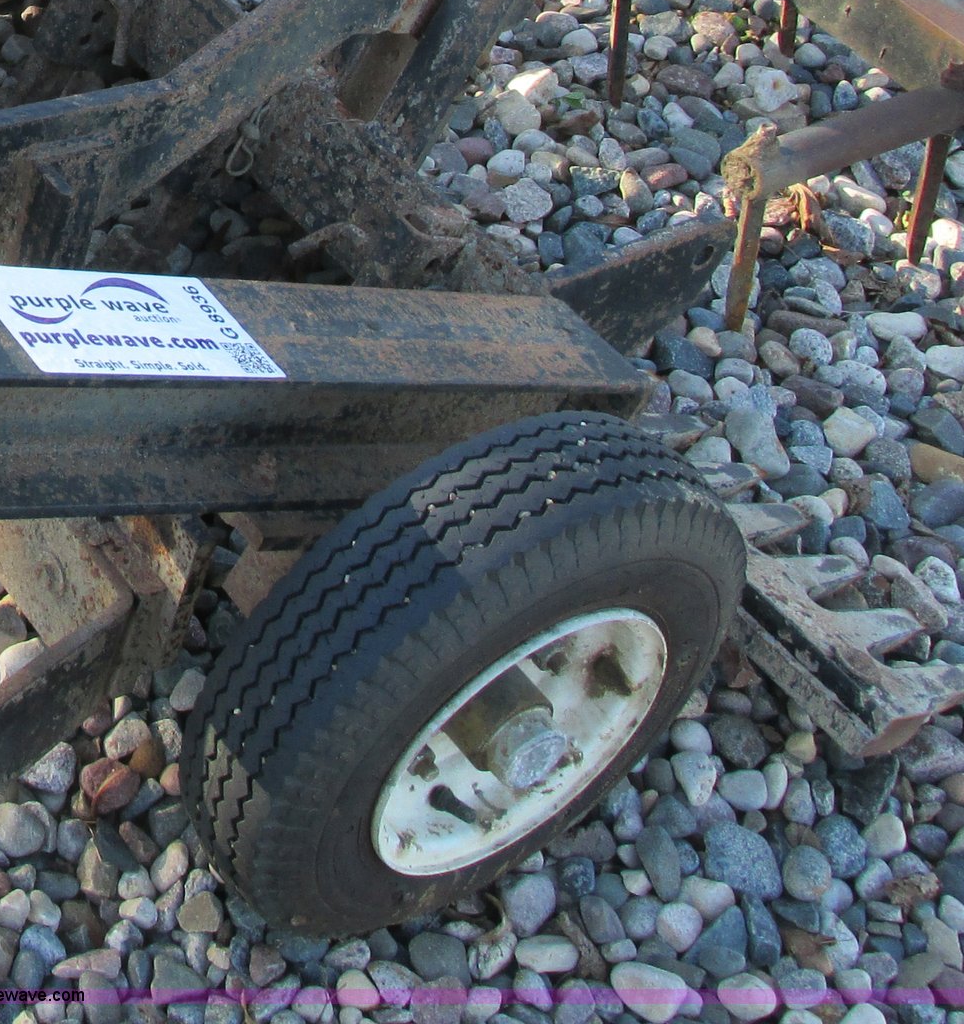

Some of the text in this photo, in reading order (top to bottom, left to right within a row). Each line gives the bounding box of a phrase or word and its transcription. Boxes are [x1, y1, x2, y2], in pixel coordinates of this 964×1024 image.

[10, 294, 169, 314] purple wave
[182, 285, 239, 340] G 8936
[19, 328, 220, 351] purplewave.com
[74, 358, 210, 372] Straight. Simple. Sold.
